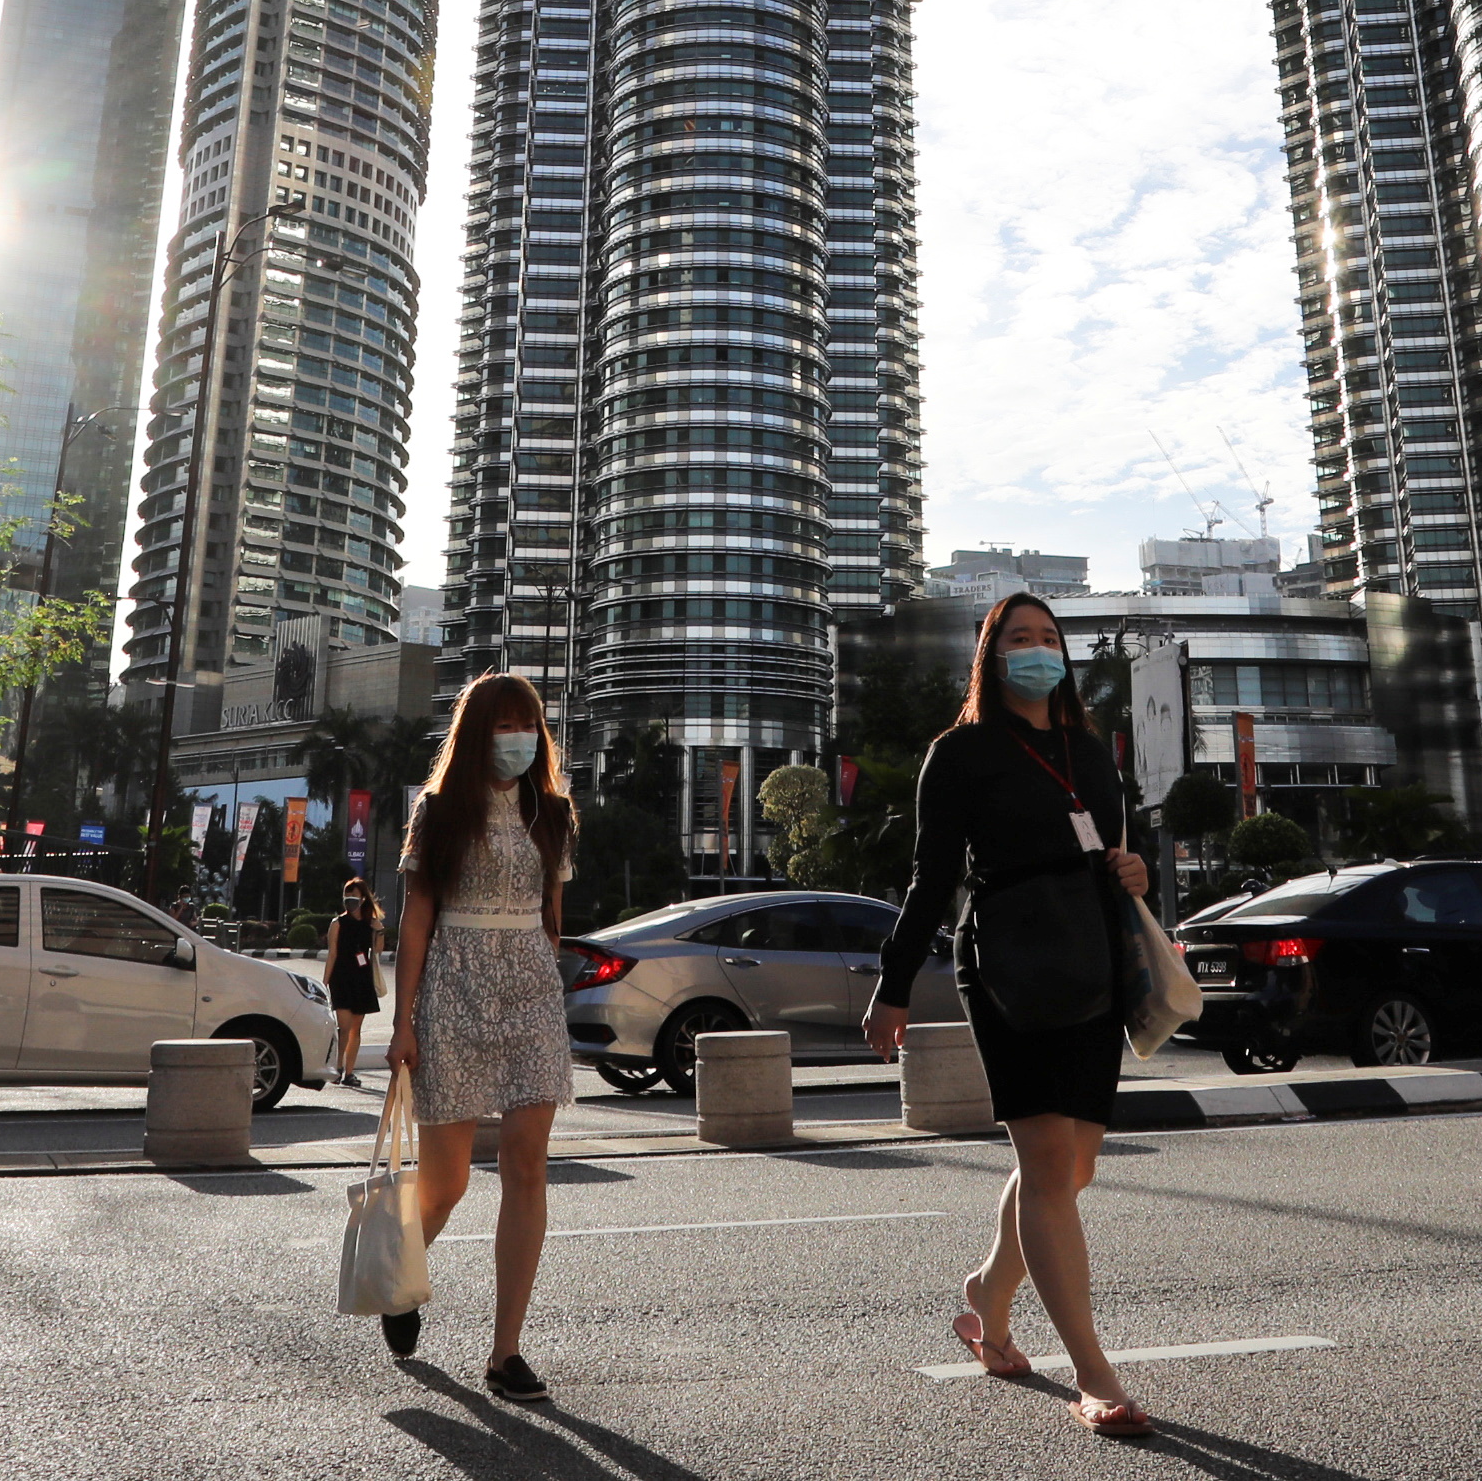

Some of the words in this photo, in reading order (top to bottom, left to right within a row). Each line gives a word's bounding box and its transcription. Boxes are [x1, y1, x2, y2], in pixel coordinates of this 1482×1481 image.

[953, 584, 992, 594] TRADERS
[221, 704, 259, 728] SURIA
[262, 698, 294, 722] KLCC
